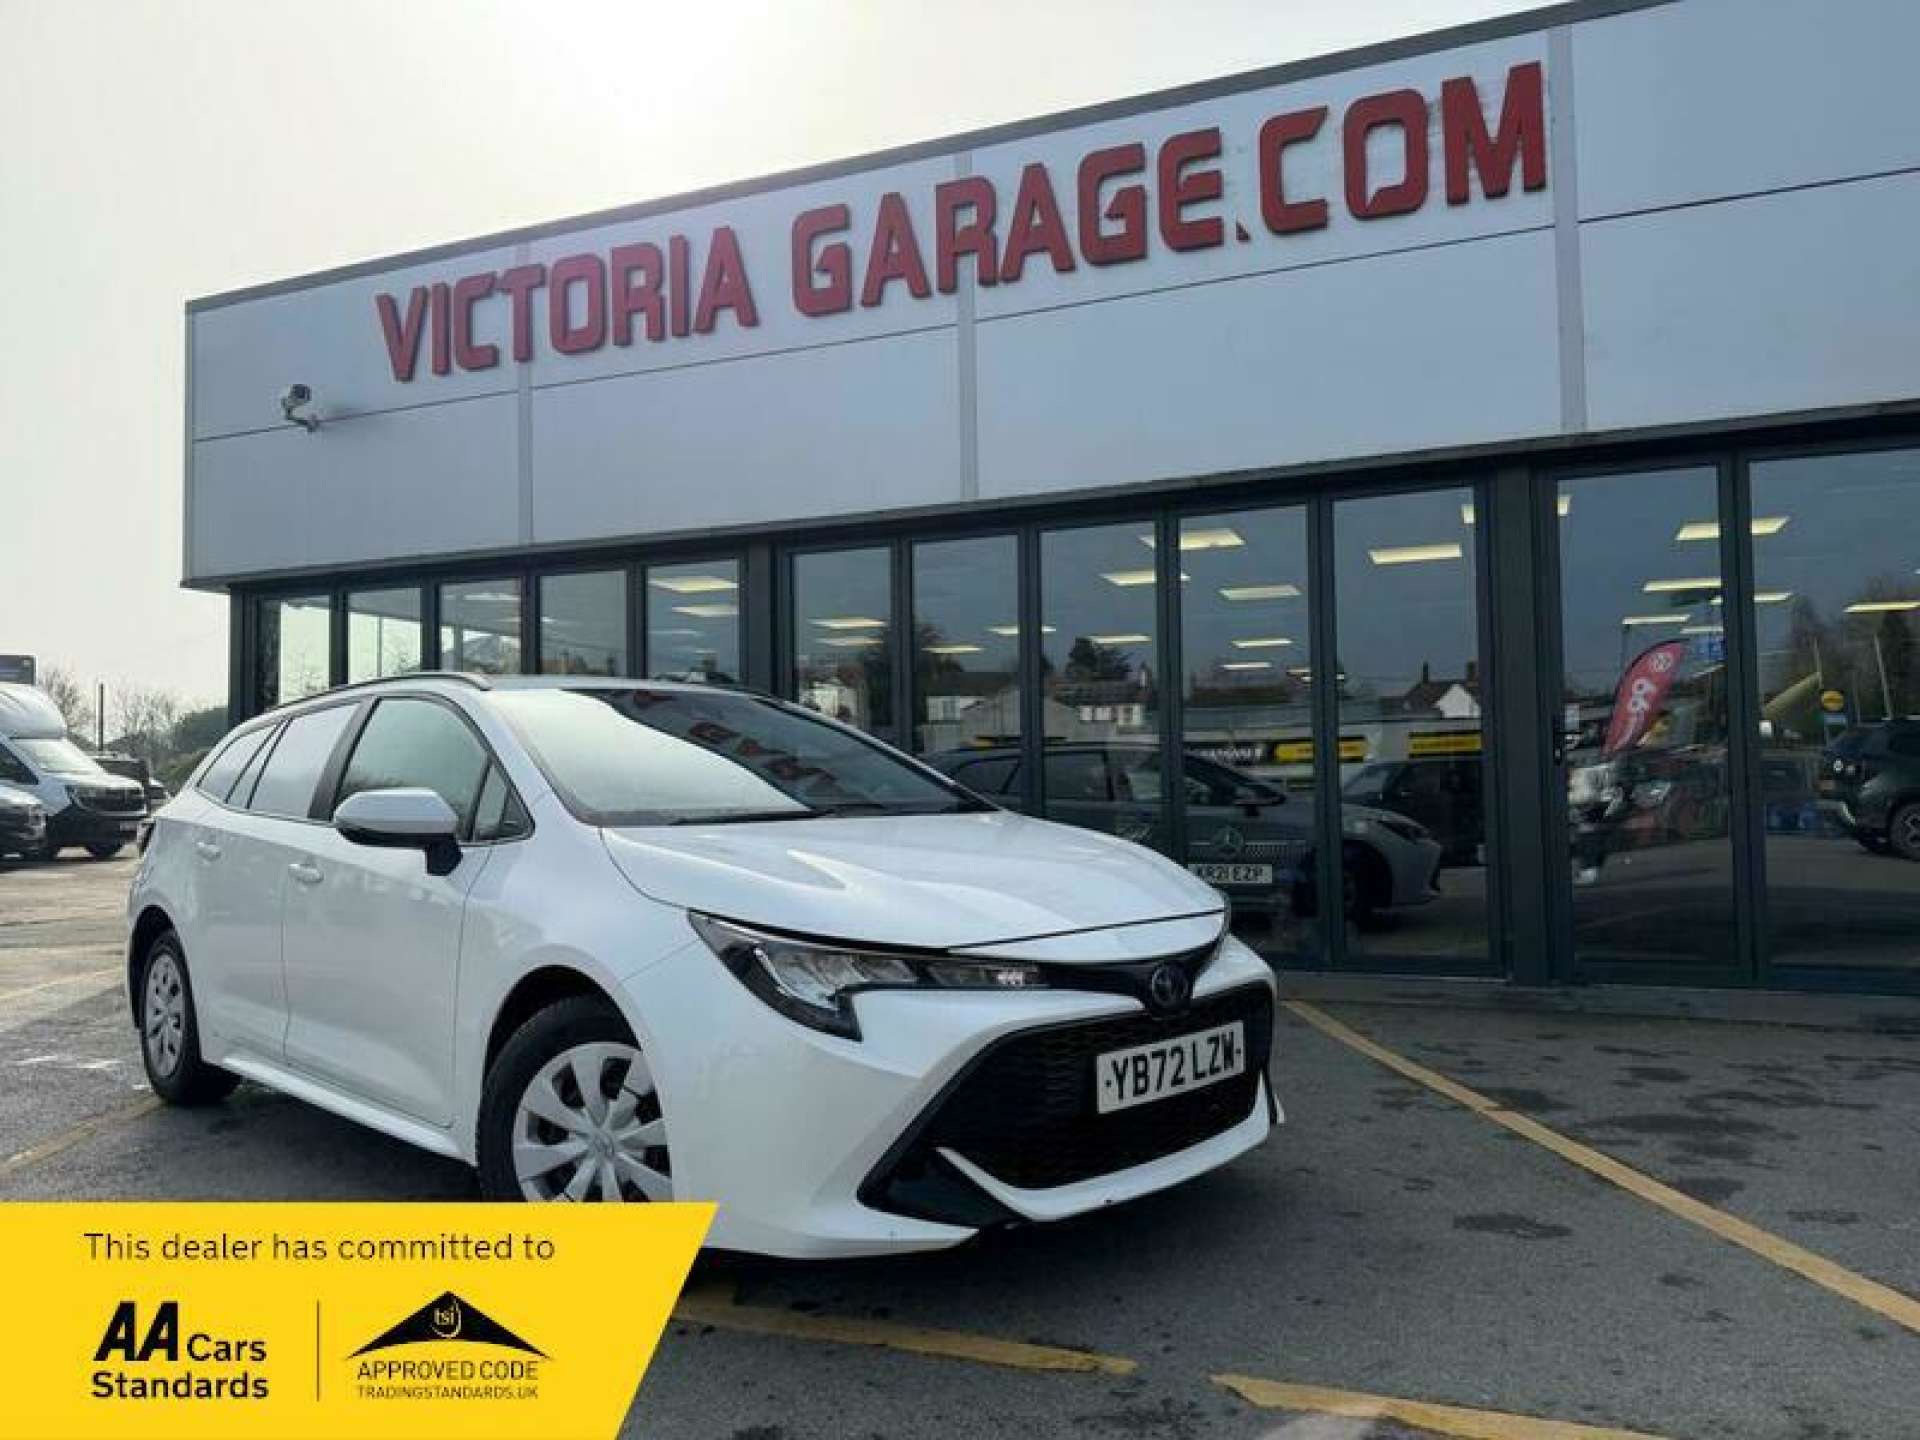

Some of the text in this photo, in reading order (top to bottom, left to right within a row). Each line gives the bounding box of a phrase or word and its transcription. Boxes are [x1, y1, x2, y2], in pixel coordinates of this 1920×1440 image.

[376, 225, 758, 382] VICTORIA
[1111, 1031, 1235, 1100] YB72 LZW
